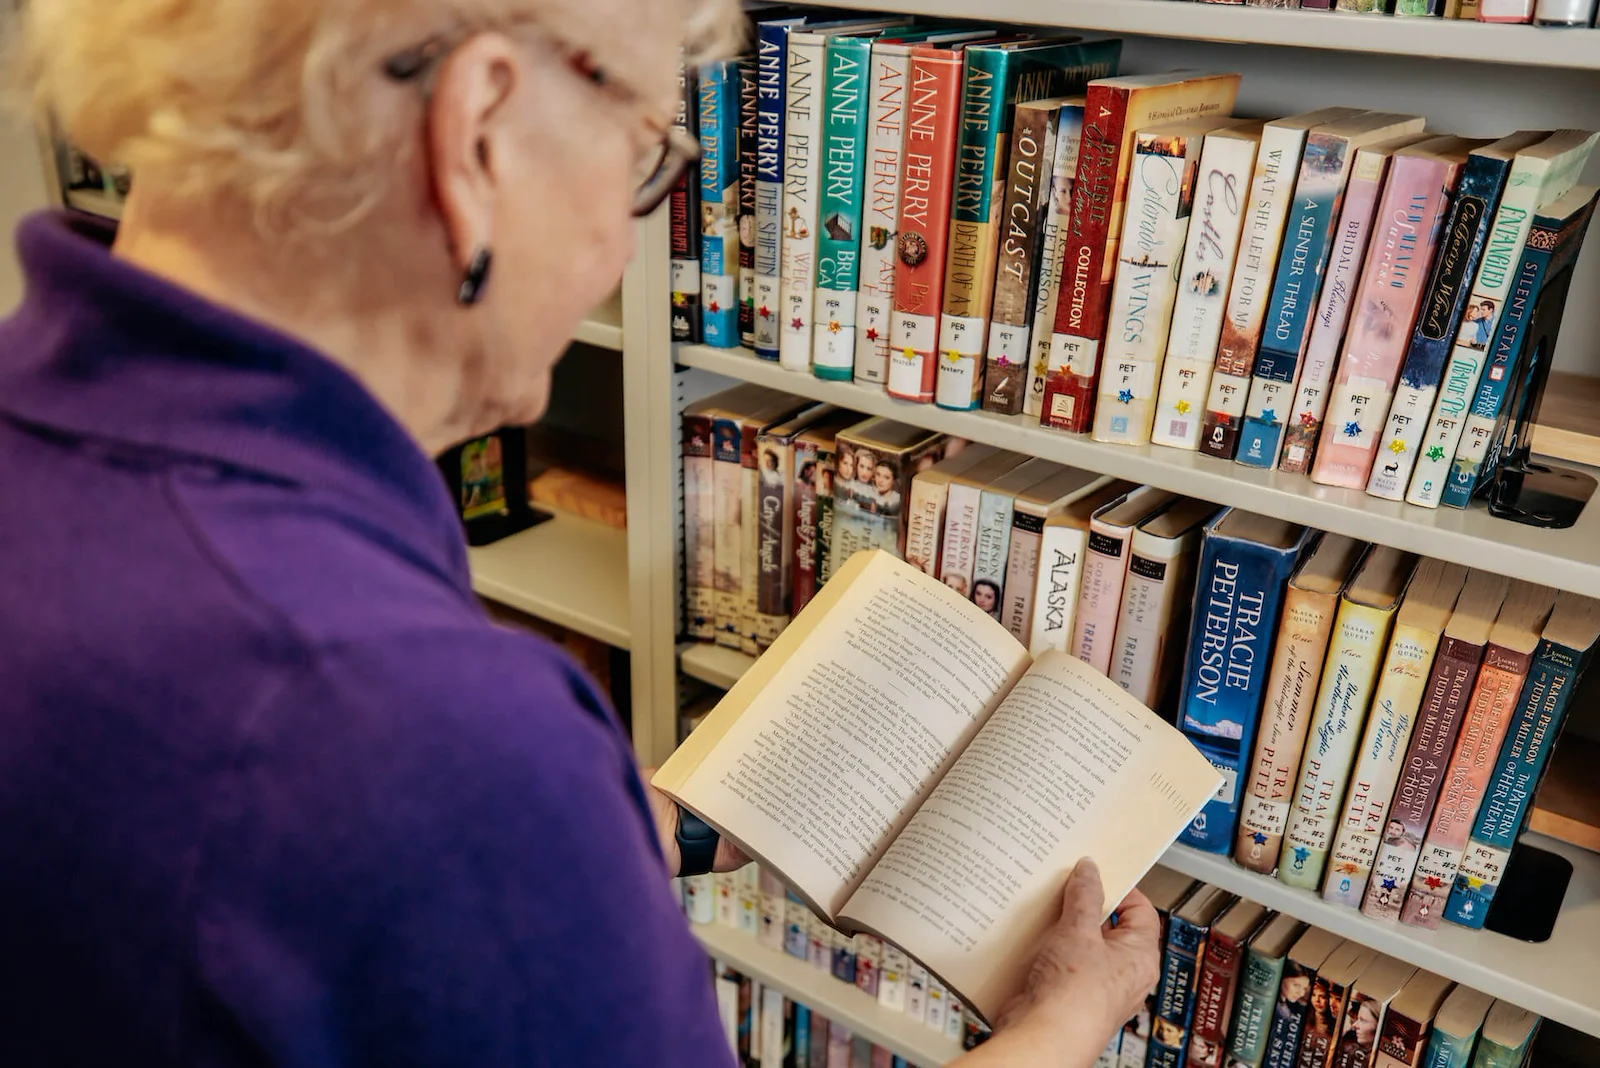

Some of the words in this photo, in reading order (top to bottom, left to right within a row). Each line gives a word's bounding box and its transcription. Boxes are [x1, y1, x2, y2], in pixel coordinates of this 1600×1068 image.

[759, 39, 780, 100] ANNE
[788, 50, 811, 121] ANNE
[700, 79, 719, 129] ANNE
[831, 53, 859, 125] ANNE
[876, 61, 902, 135] ANNE
[910, 65, 938, 141] ANNE
[964, 66, 993, 132] ANNE
[741, 79, 756, 138] ANNE
[1100, 106, 1112, 117] A
[757, 111, 779, 177] PERRY
[700, 136, 718, 193] PERRY
[787, 134, 809, 203] PERRY
[827, 137, 855, 205] PERRY
[958, 145, 986, 216] PERRY
[1262, 150, 1282, 195] WHAT
[872, 149, 897, 220] PERRY
[903, 153, 932, 227] PERRY
[1138, 154, 1178, 252] Colorado
[1004, 137, 1037, 283] OUTCAST
[1253, 201, 1271, 231] SHE
[1305, 198, 1318, 210] A
[954, 224, 978, 268] DEATH
[1246, 234, 1265, 275] LEFT
[1289, 215, 1315, 276] SLENDER
[1339, 221, 1359, 270] BRIDAL
[1479, 205, 1527, 289] ENTANGLED
[952, 270, 973, 289] OF
[1036, 224, 1058, 315] PETERSON
[1069, 246, 1091, 329] COLLECTION
[1123, 274, 1152, 344] WINGS
[1240, 277, 1257, 311] FOR
[1509, 261, 1538, 320] SILENT
[903, 321, 916, 329] PER
[951, 322, 965, 331] PER
[1275, 281, 1303, 340] THREAD
[1000, 332, 1012, 340] PET
[1064, 343, 1080, 351] PET
[1494, 325, 1518, 363] STAR
[1119, 364, 1136, 372] PET
[1179, 369, 1196, 379] PET
[1447, 358, 1477, 396] TRACIE
[1220, 385, 1237, 394] PET
[1263, 384, 1281, 394] PET
[1303, 388, 1319, 397] PET
[1351, 395, 1370, 405] PET
[1393, 415, 1412, 425] PET
[1437, 419, 1457, 429] PET
[1471, 427, 1491, 438] PET
[947, 520, 959, 568] MILLER
[959, 505, 973, 570] PETERSON
[977, 526, 991, 573] MILLER
[990, 512, 1005, 577] PETERSON
[1045, 549, 1076, 631] ALASKA
[1011, 596, 1024, 634] TRACIE
[1196, 559, 1239, 706] PETERSON
[1079, 623, 1096, 663] TRACIE
[1121, 637, 1137, 677] TRACIE
[1226, 591, 1264, 690] TRACIE
[1289, 660, 1312, 731] Summer
[1428, 675, 1449, 713] JUDITH
[1448, 669, 1468, 706] TRACIE
[1472, 687, 1492, 724] JUDITH
[1491, 681, 1512, 718] TRACIE
[1525, 681, 1545, 719] JUDITH
[1544, 676, 1566, 714] TRACIE
[1417, 714, 1434, 751] MILLER
[1433, 707, 1456, 757] PETERSON
[1460, 726, 1479, 762] MILLER
[1475, 719, 1498, 768] PETERSON
[1510, 722, 1531, 758] MILLER
[1525, 714, 1551, 765] PETERSON
[1425, 760, 1436, 770] A
[1506, 761, 1517, 773] OF
[1517, 773, 1530, 789] THE
[1399, 773, 1416, 807] HOPE
[1409, 773, 1435, 825] TAPESTRY
[1448, 766, 1469, 806] WOVEN
[1498, 773, 1514, 800] HER
[1246, 819, 1272, 832] Series
[1258, 802, 1275, 811] PET
[1268, 813, 1279, 822] #1
[1303, 817, 1320, 826] PET
[1436, 806, 1454, 835] TRUE
[1456, 795, 1474, 823] LOVE
[1482, 801, 1505, 839] HEART
[1497, 789, 1527, 839] PATTERN
[1289, 834, 1316, 847] Series
[1312, 829, 1325, 838] #2
[1351, 835, 1369, 844] PET
[1360, 848, 1373, 856] #3
[1433, 848, 1452, 857] PET
[1335, 853, 1363, 865] Series
[1418, 866, 1449, 878] Series
[1442, 862, 1456, 870] #2
[1460, 865, 1487, 879] Series
[1476, 848, 1495, 859] PET
[1484, 863, 1498, 871] #3
[1173, 971, 1188, 1014] TRACIE
[1205, 986, 1221, 1030] TRACIE
[1245, 1008, 1262, 1050] TRACIE
